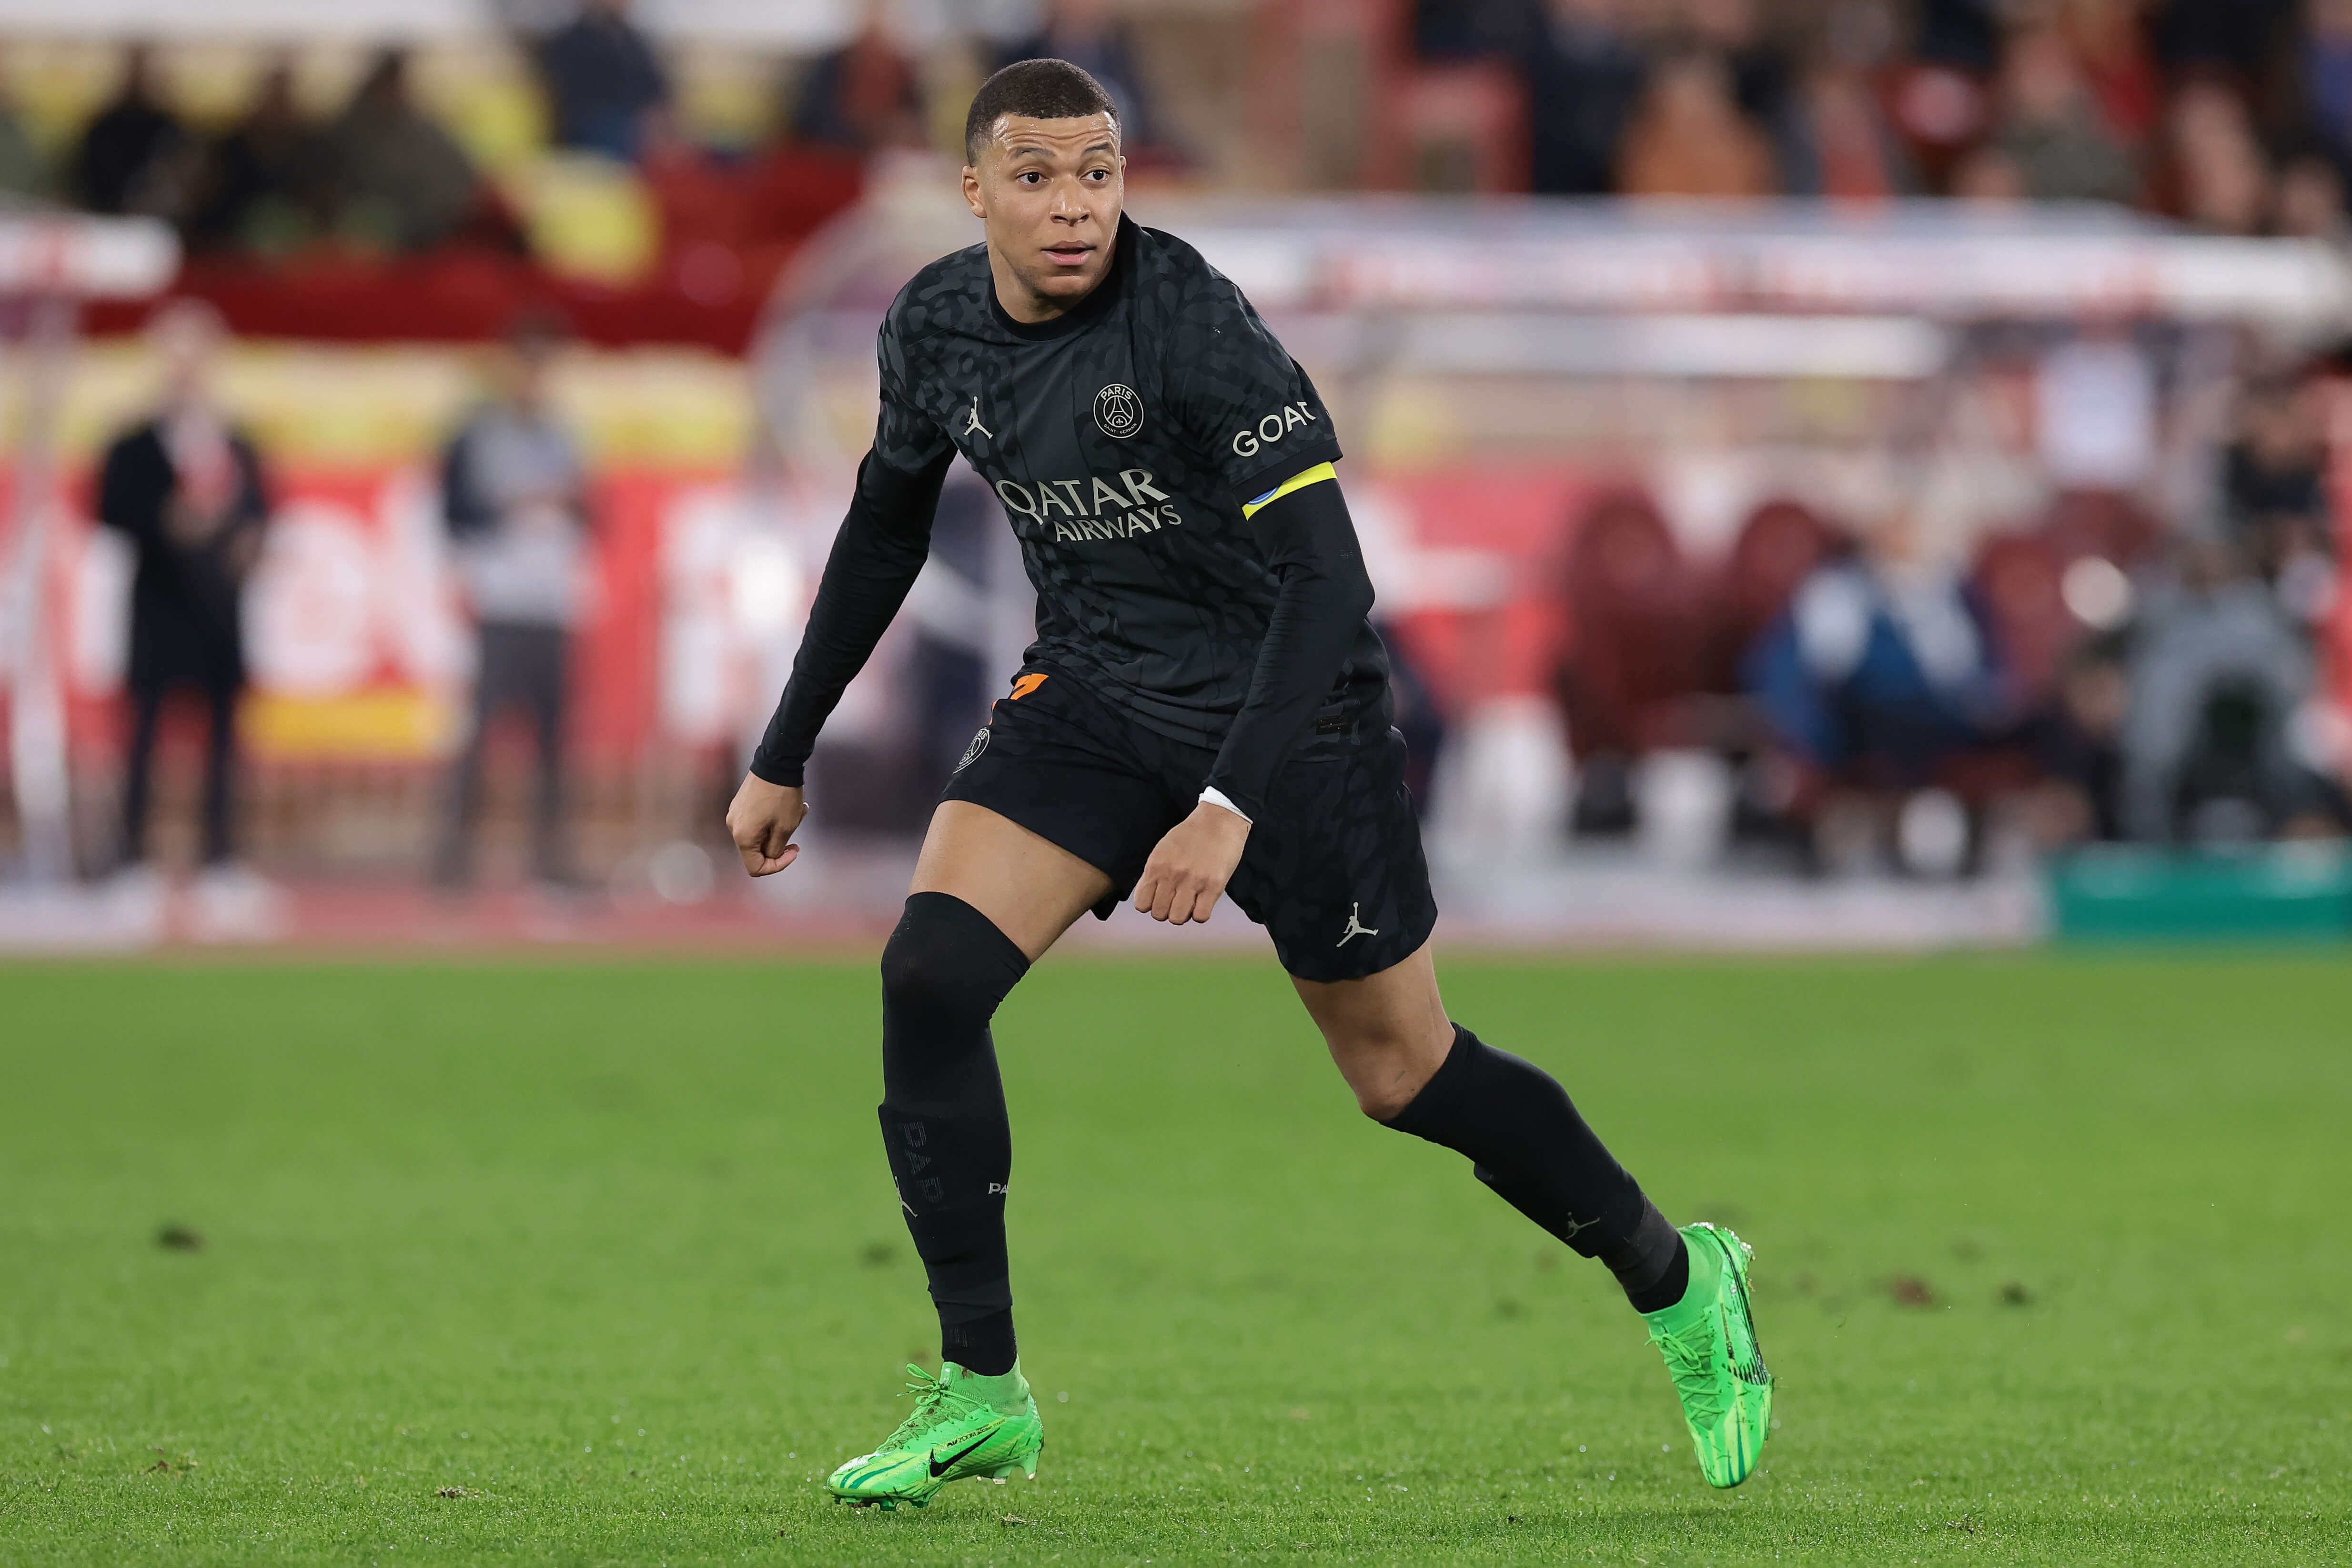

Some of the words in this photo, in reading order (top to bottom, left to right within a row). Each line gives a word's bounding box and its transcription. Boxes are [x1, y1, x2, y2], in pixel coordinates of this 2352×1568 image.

[1100, 386, 1132, 400] PARIS
[1233, 401, 1316, 457] GOAT
[996, 468, 1171, 525] QATAR
[1054, 504, 1182, 542] AIRWAYS
